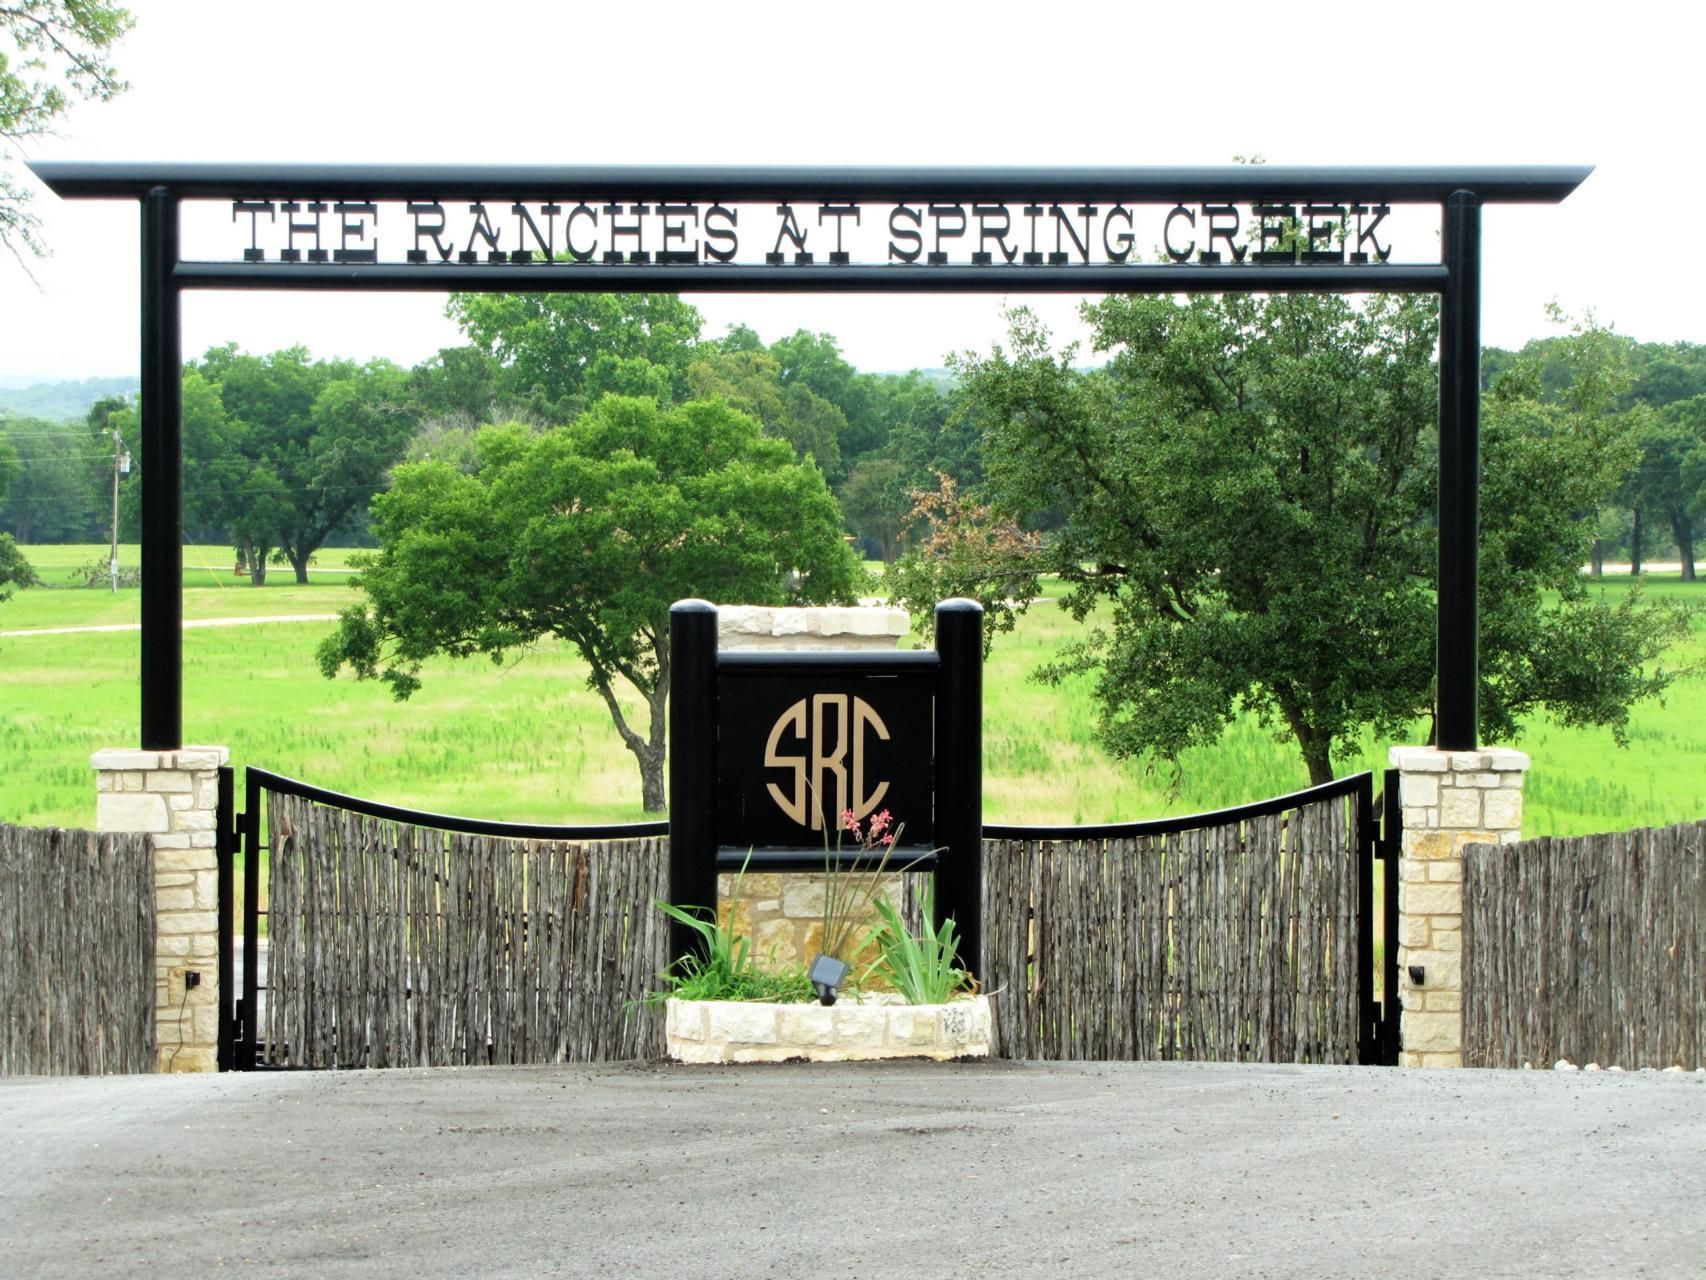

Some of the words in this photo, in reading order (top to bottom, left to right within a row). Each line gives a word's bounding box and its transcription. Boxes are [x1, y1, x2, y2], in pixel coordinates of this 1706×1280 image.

[232, 203, 378, 262] THE
[406, 203, 739, 263] RANCHES
[766, 204, 861, 264] AT
[888, 204, 1135, 265] SPRING
[1163, 204, 1393, 265] CREEK
[764, 693, 891, 831] SRC
